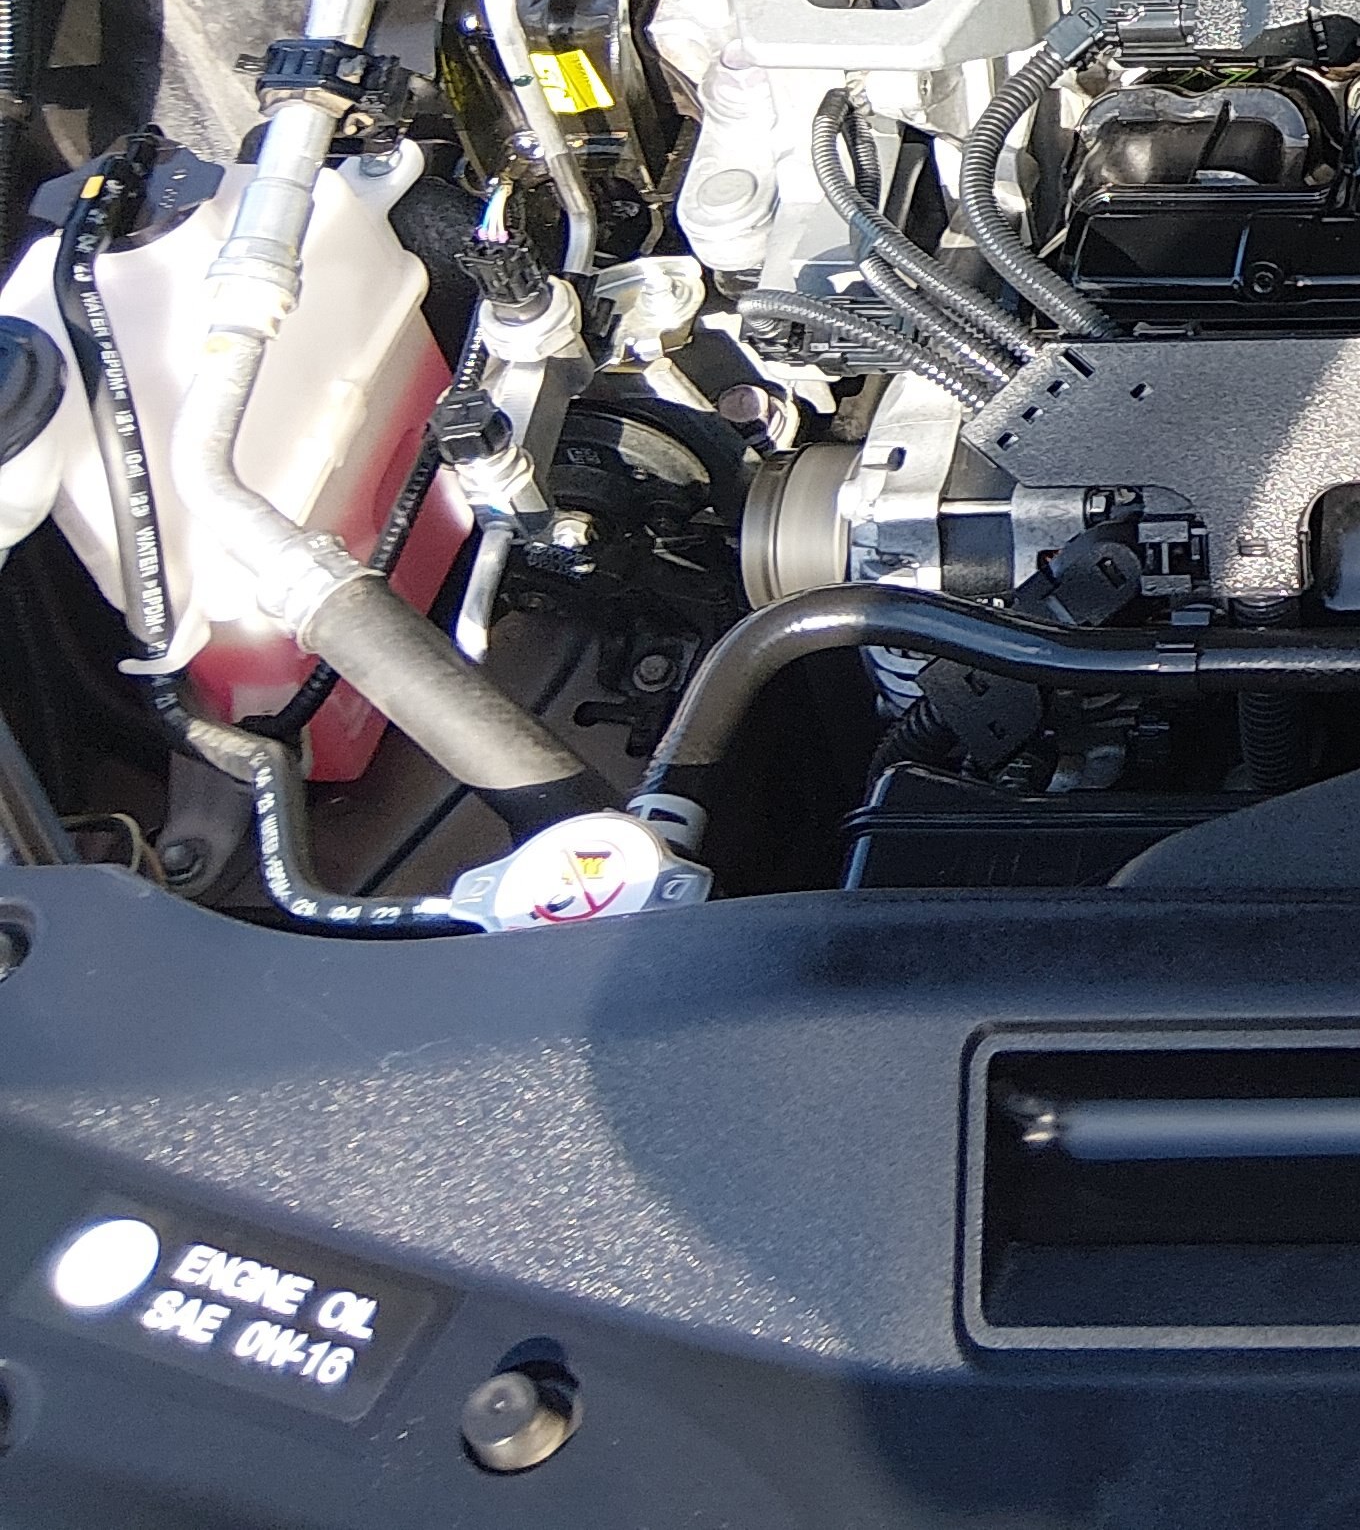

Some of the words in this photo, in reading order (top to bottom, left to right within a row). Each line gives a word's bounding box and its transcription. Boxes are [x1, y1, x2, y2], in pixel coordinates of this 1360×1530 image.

[141, 1290, 232, 1344] SAE
[234, 1321, 356, 1385] 0W-16
[171, 1243, 316, 1315] ENGINE
[315, 1290, 380, 1341] OIL
